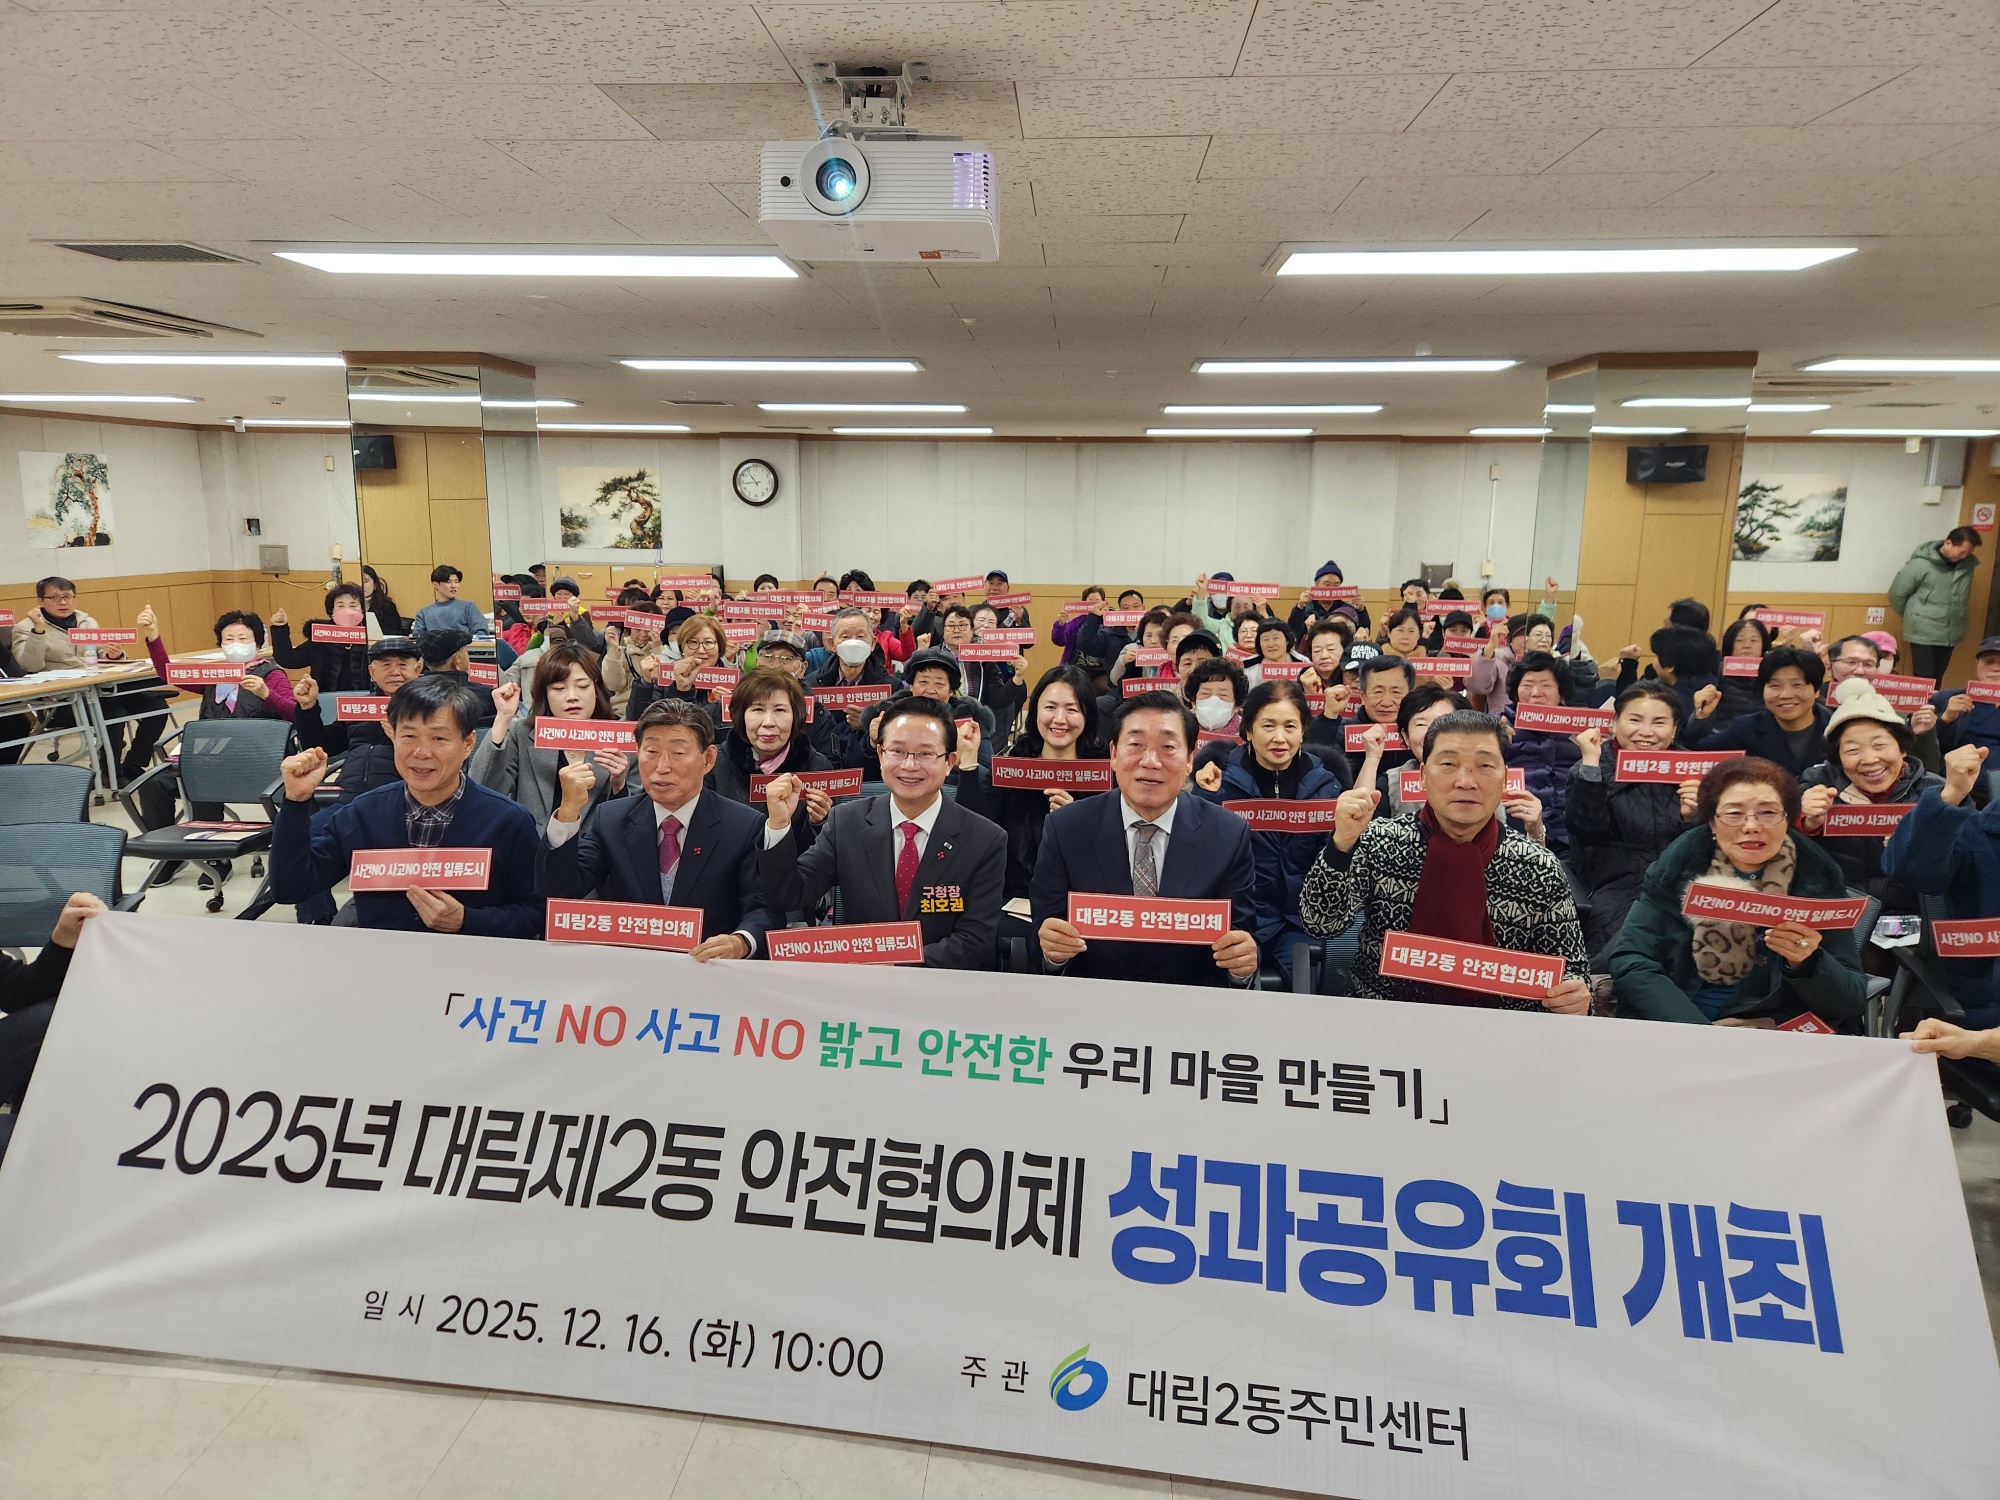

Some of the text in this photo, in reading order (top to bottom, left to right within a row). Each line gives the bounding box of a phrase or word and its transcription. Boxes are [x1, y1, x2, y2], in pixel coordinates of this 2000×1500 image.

[727, 606, 750, 614] 대림2동
[751, 607, 783, 616] 안전협의체
[804, 617, 828, 627] 대림2동
[71, 632, 136, 640] 대림2동 안전협의체
[170, 665, 242, 679] 대림2동 안전협의체
[695, 673, 736, 684] 안전협의체
[1264, 667, 1288, 675] 대림2동
[1126, 683, 1153, 692] 대림2동
[846, 692, 888, 703] 안전협의체
[341, 703, 378, 714] 대림2동
[1518, 710, 1544, 722] 사건NO
[1545, 713, 1571, 724] 사고NO
[538, 727, 567, 739] 사건NO
[568, 728, 596, 741] 사고NO
[598, 731, 615, 743] 안전
[995, 766, 1108, 782] 사건NO 사고NO 안전 일류도시
[1622, 759, 1671, 774] 대림2동
[812, 780, 828, 790] 안전
[829, 777, 859, 790] 일류도시
[1256, 809, 1287, 821] 사고NO
[1289, 811, 1306, 823] 안전
[1308, 811, 1336, 823] 일류도
[1829, 814, 1903, 827] 사건NO 사고NO
[354, 861, 485, 879] 사건NO 사고NO 안전 일류도시
[922, 885, 961, 898] 구청장
[920, 897, 965, 914] 최호권
[1690, 894, 1860, 923] 사건NO 사고NO 안전 일류도시
[555, 912, 695, 939] 대림2동 안전협의체
[1076, 907, 1222, 932] 대림2동 안전협의체
[774, 934, 917, 957] 사건NO 사고NO 안전 일류도시
[1940, 931, 1984, 946] 사건NO
[1391, 946, 1555, 989] 대림2동 안전협의체
[555, 1003, 627, 1047] NO
[636, 1007, 720, 1055] 사고
[733, 1015, 805, 1061] NO
[819, 1021, 903, 1071] 밝고
[916, 1028, 1053, 1086] 안전한
[1062, 1042, 1152, 1096] 우리
[1170, 1050, 1264, 1105] 마을
[117, 1082, 1845, 1355] 2025년 대림제2동 안전협의체 성과공유회 개최
[436, 1294, 544, 1344] 2025.
[562, 1306, 607, 1351] 12.
[625, 1313, 671, 1358] 16.
[688, 1317, 757, 1370] (화)
[770, 1328, 885, 1382] 10:00
[1126, 1369, 1471, 1462] 대림2동주민센터
